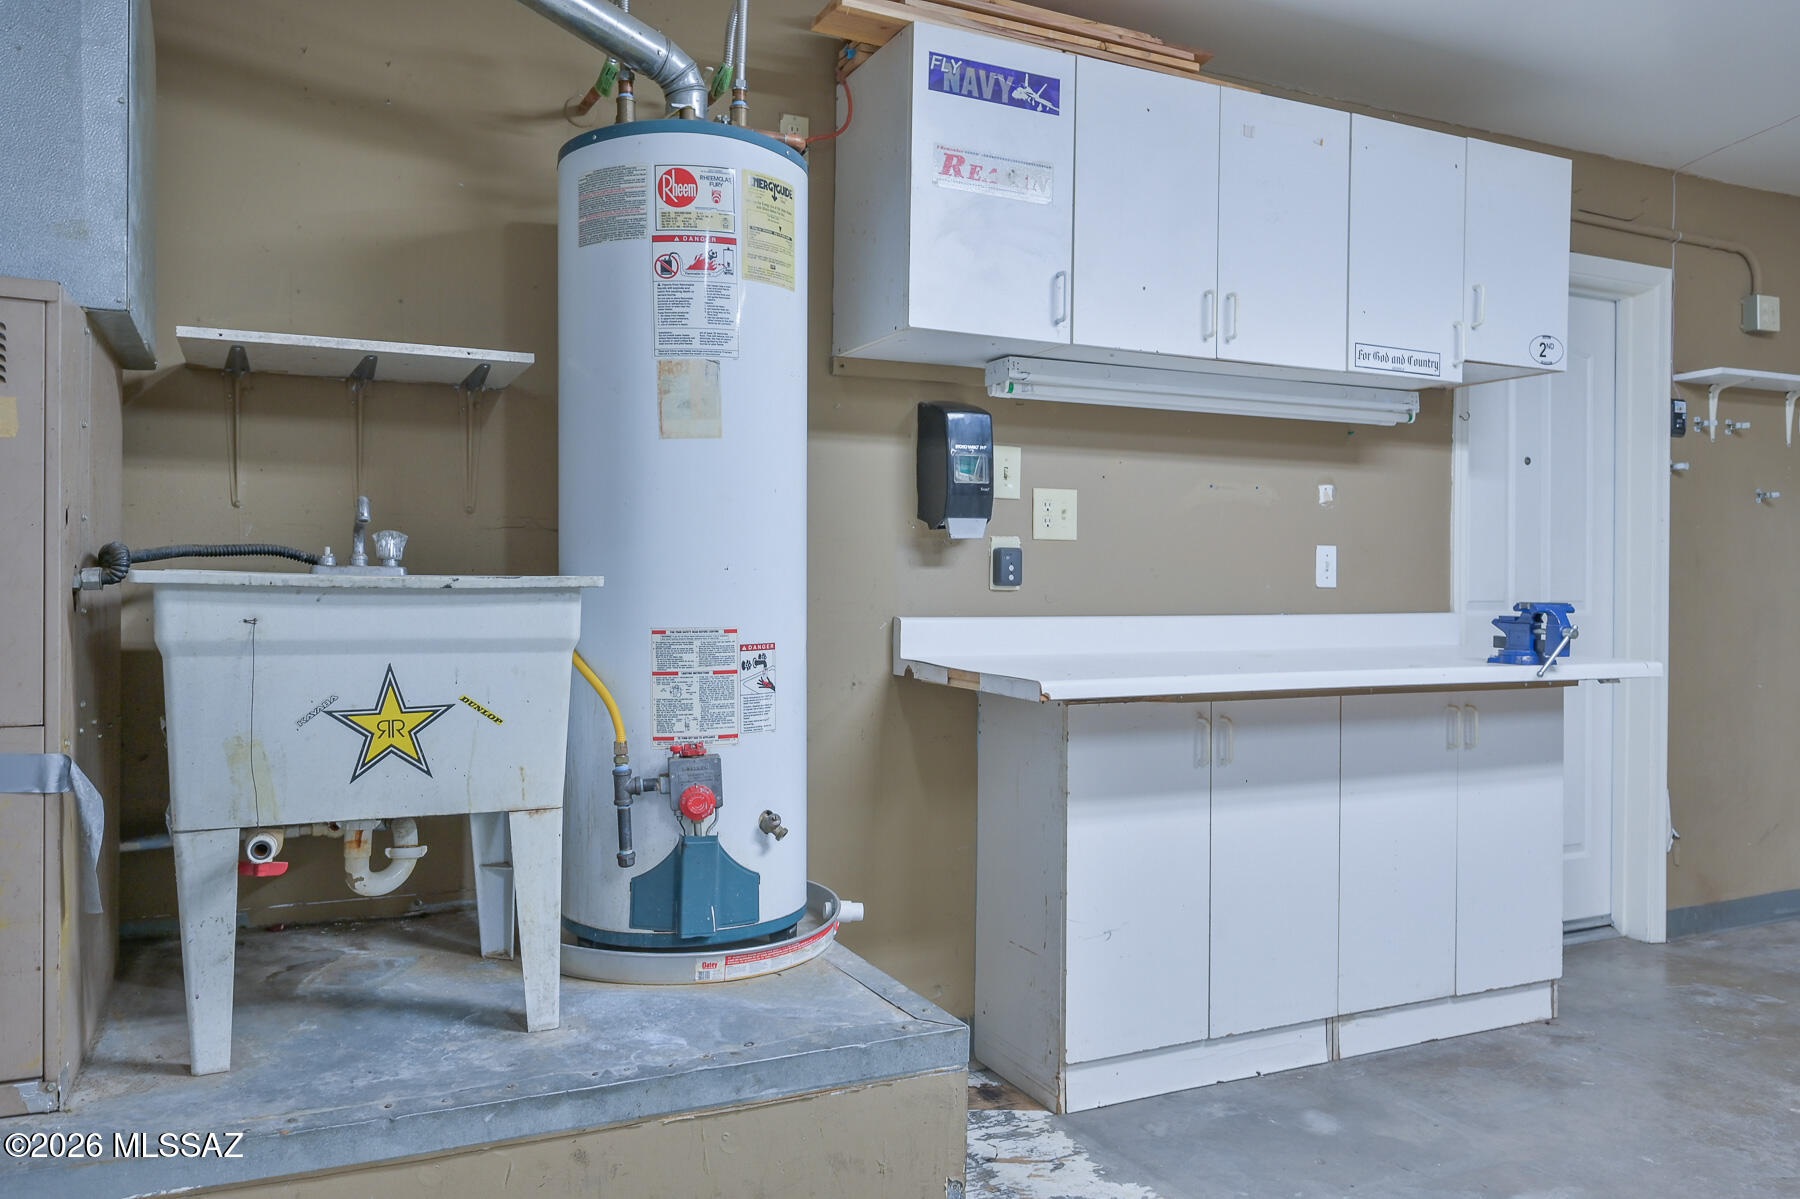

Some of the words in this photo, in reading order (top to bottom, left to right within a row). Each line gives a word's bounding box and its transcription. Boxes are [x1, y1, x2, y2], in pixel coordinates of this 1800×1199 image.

[930, 55, 962, 74] FLY
[943, 63, 1014, 103] NAVY
[662, 169, 697, 202] Rheem
[1357, 349, 1371, 361] For
[1373, 351, 1389, 363] God
[1391, 353, 1406, 365] and
[1407, 355, 1439, 371] Country
[459, 695, 503, 725] DUNLOP
